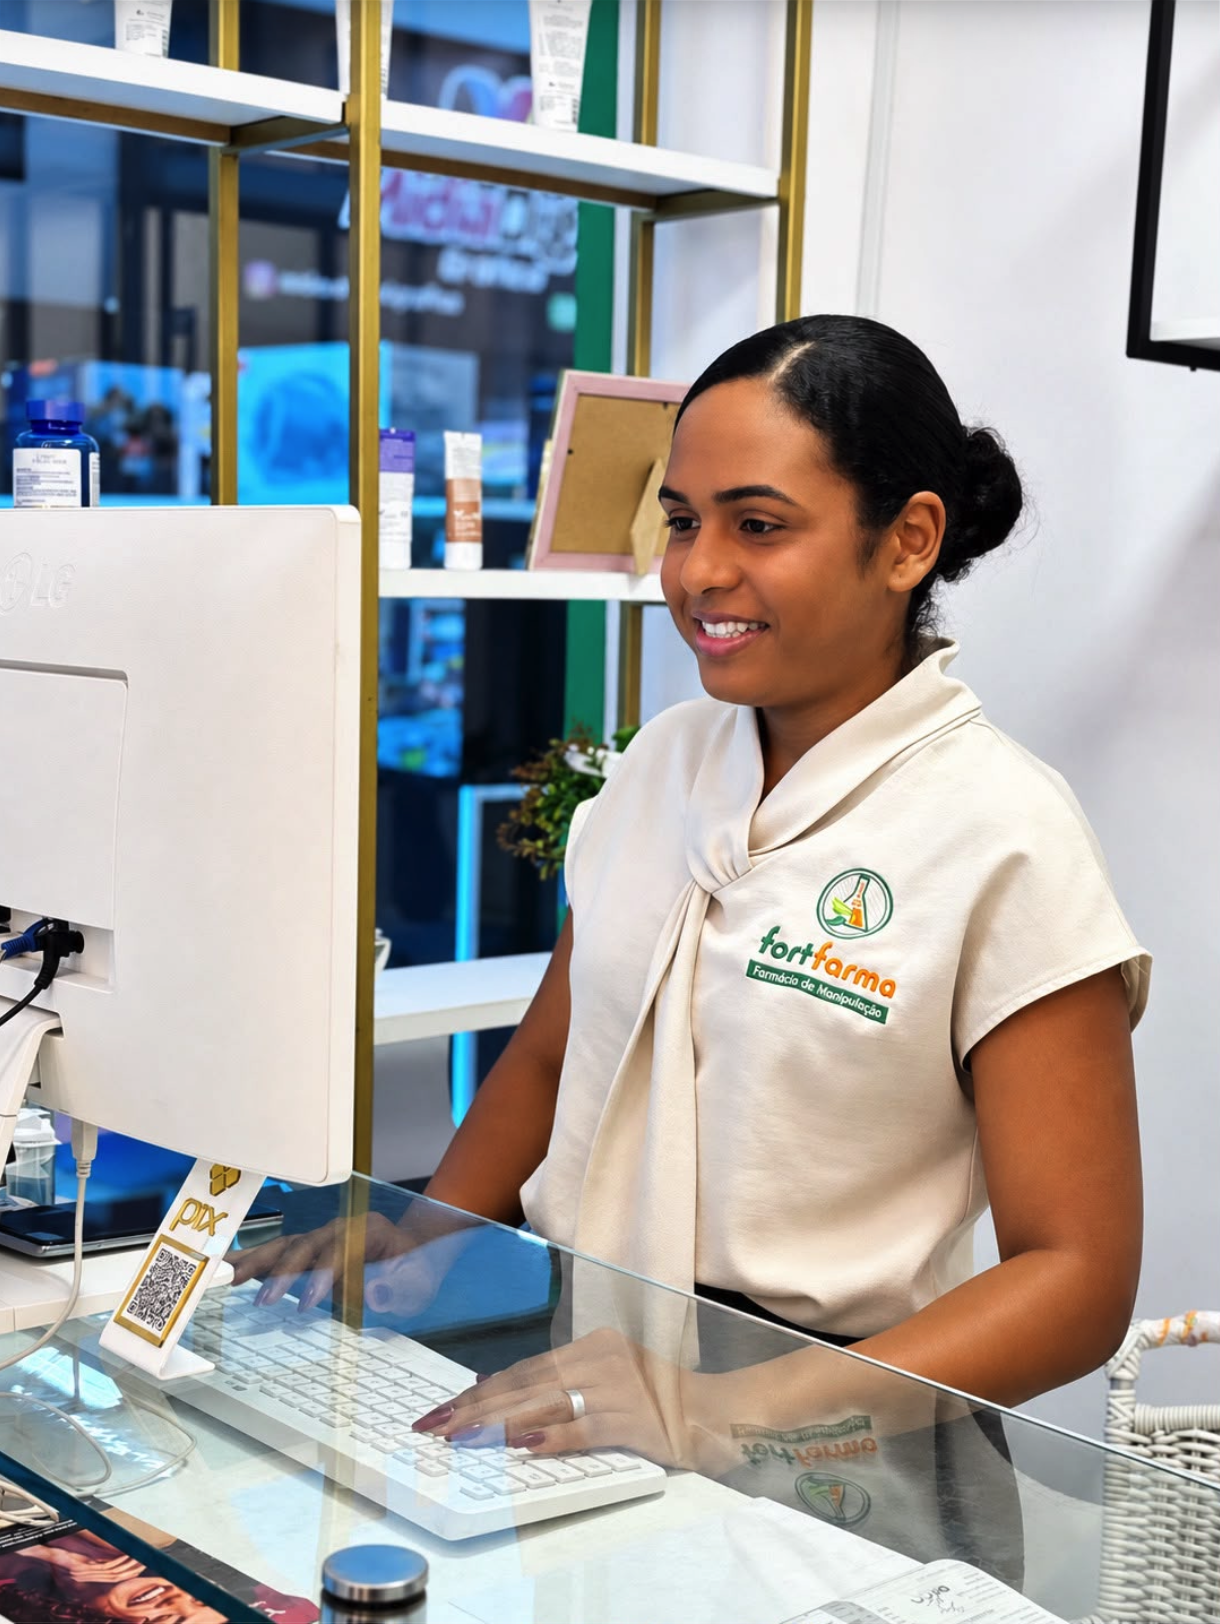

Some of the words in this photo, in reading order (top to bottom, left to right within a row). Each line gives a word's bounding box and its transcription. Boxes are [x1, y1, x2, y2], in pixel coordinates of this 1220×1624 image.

[758, 925, 897, 999] fortfarma
[801, 978, 815, 991] de
[816, 983, 882, 1018] Manipulação
[169, 1198, 229, 1236] pix
